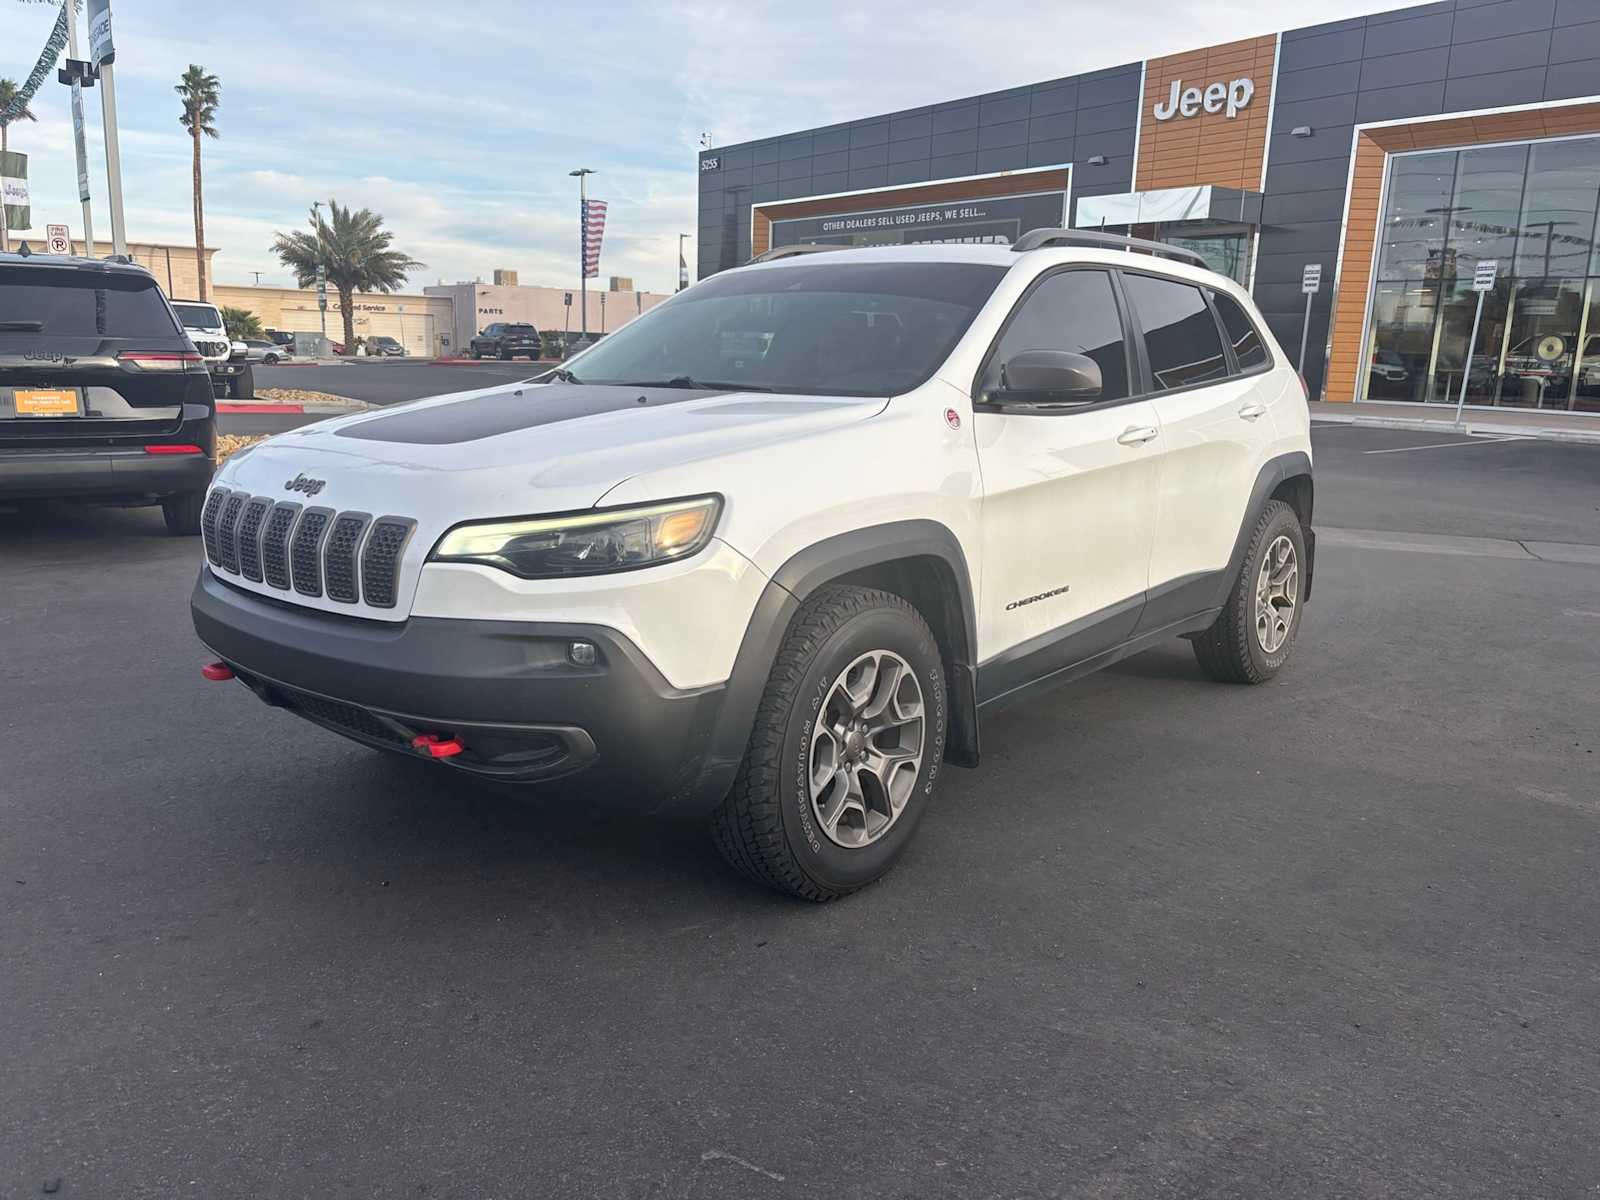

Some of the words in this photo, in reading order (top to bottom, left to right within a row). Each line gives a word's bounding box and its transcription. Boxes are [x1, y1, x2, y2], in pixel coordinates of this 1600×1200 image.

[1154, 78, 1254, 120] Jeep
[823, 221, 845, 231] OTHER
[846, 218, 877, 229] DEALERS
[878, 215, 894, 226] SELL
[896, 214, 916, 224] USED
[918, 211, 943, 222] JEEPS,
[945, 209, 958, 219] WE
[24, 351, 63, 363] Jeep
[285, 472, 327, 498] Jeep
[1005, 585, 1070, 611] CHEROKEE
